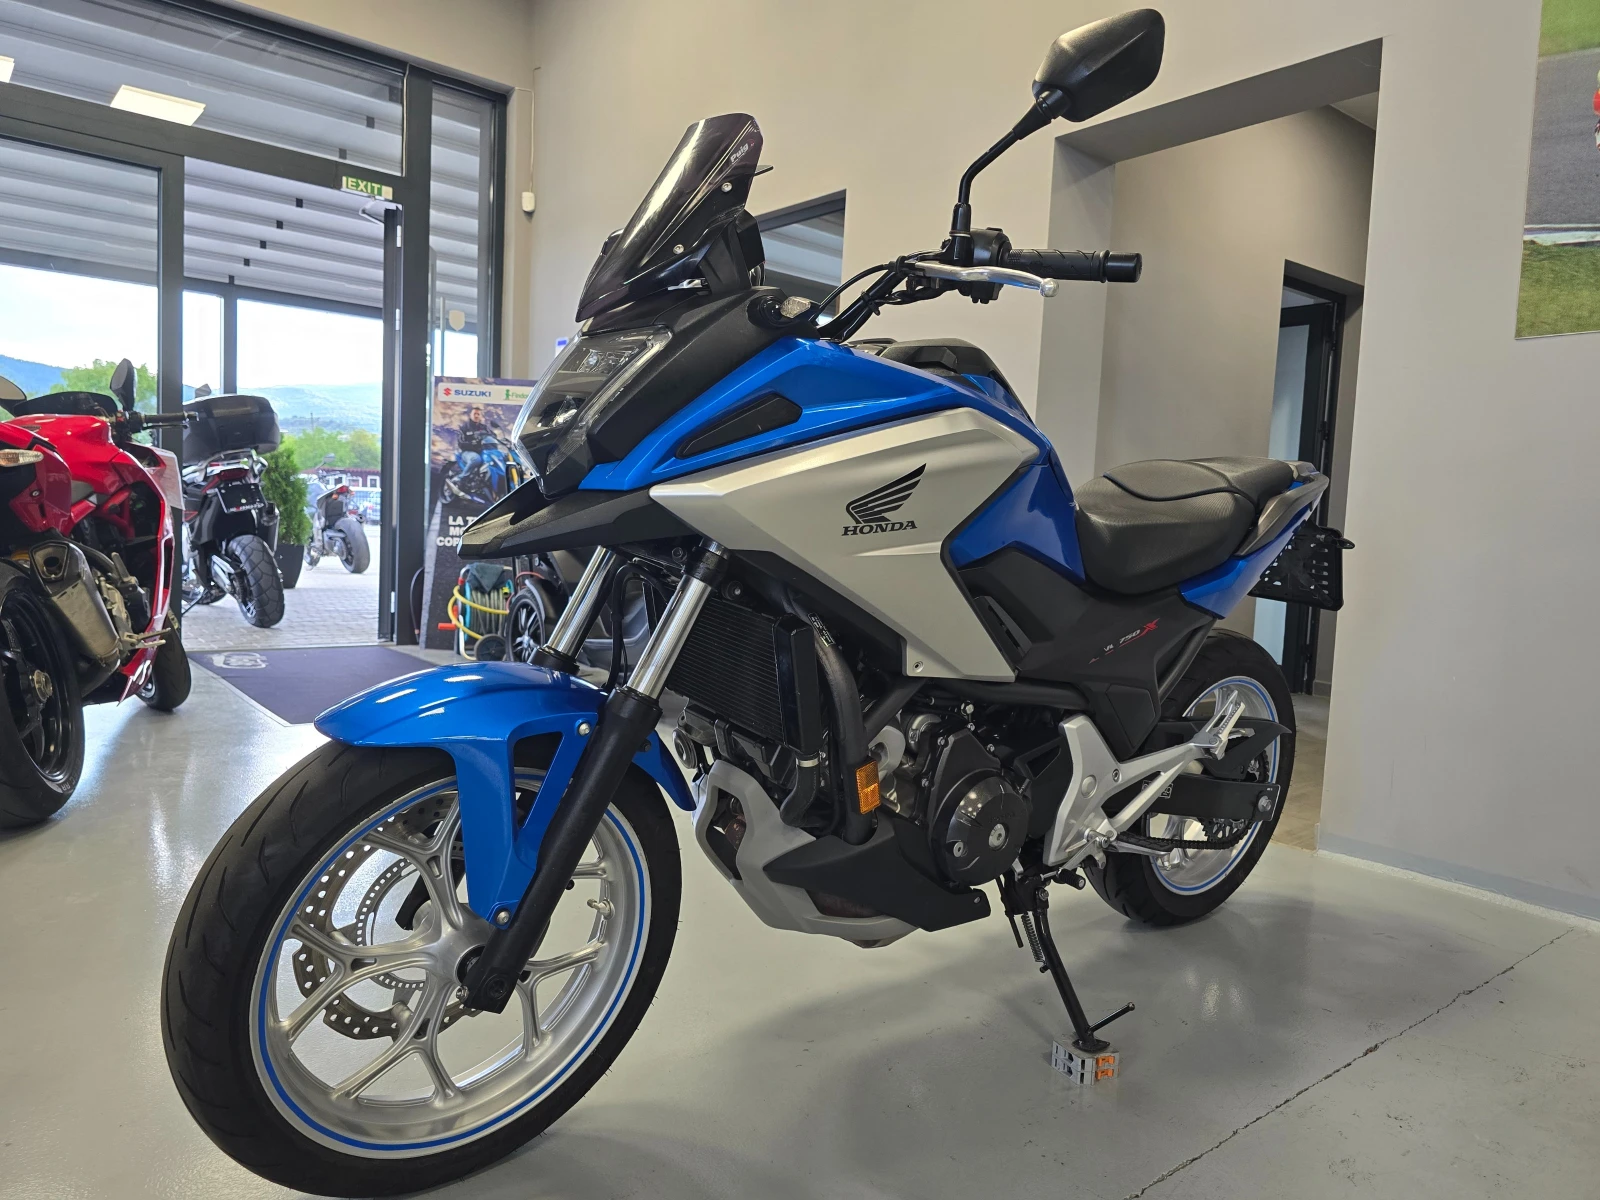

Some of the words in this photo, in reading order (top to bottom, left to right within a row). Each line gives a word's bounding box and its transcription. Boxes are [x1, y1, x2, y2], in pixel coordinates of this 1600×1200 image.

[730, 143, 749, 163] Puig
[347, 177, 381, 195] EXIT
[454, 389, 492, 397] SUZUKI
[448, 515, 465, 526] LA
[841, 520, 918, 536] HONDA
